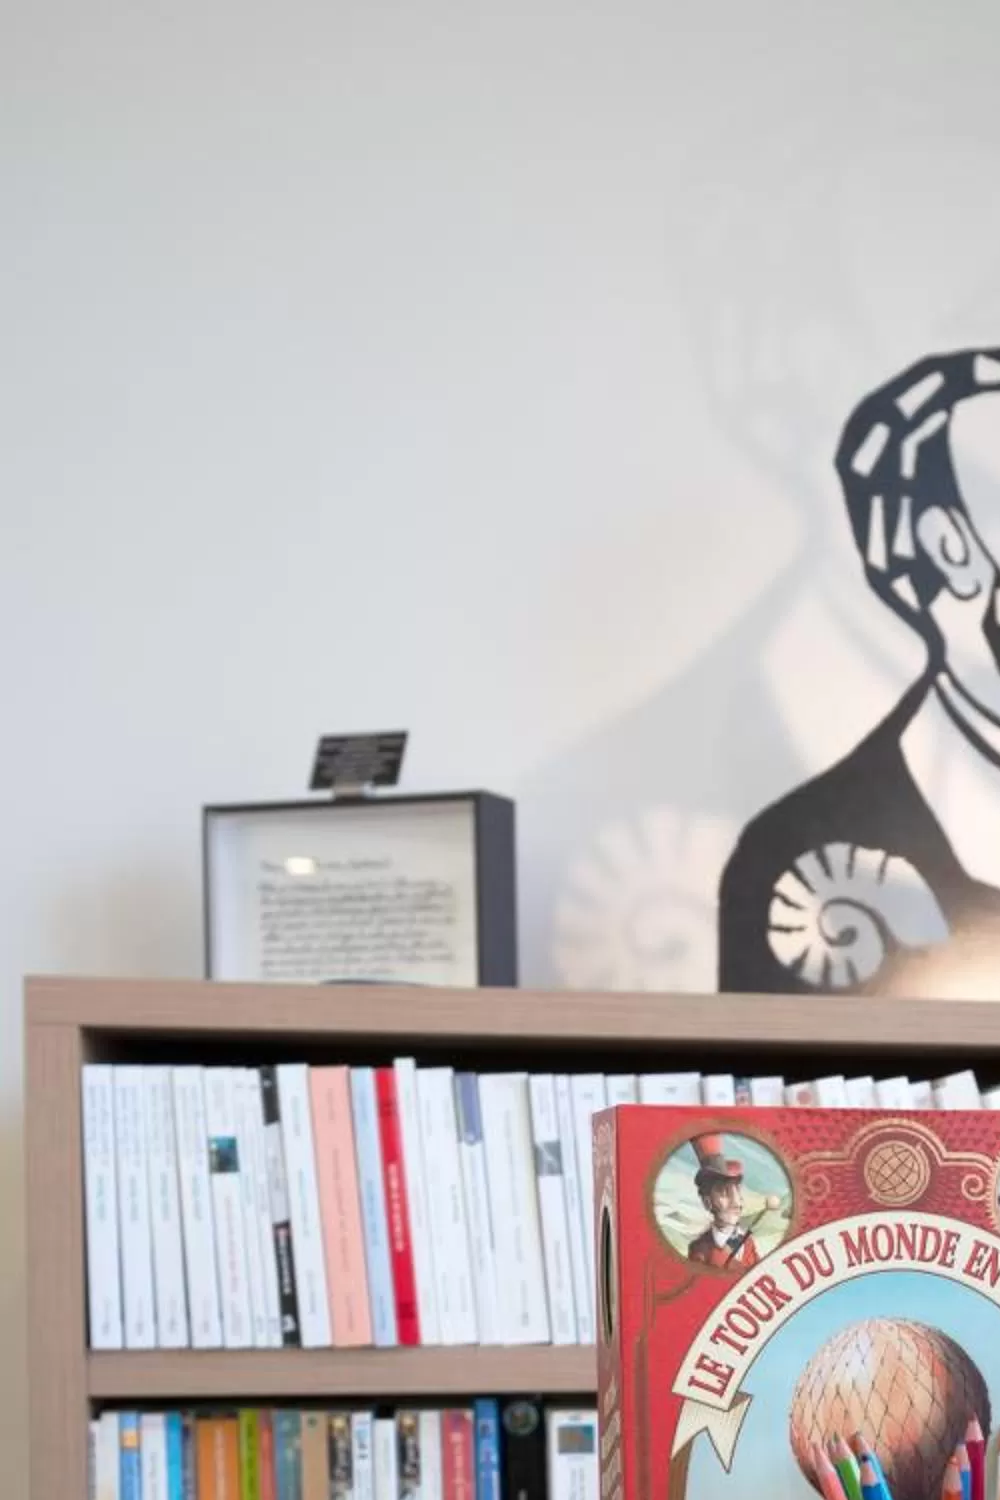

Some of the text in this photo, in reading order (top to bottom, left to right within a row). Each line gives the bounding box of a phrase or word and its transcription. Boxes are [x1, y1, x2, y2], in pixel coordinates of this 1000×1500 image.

[687, 1353, 735, 1399] LE
[711, 1280, 793, 1353] TOUR
[783, 1241, 835, 1291] DU
[839, 1222, 961, 1269] MONDE
